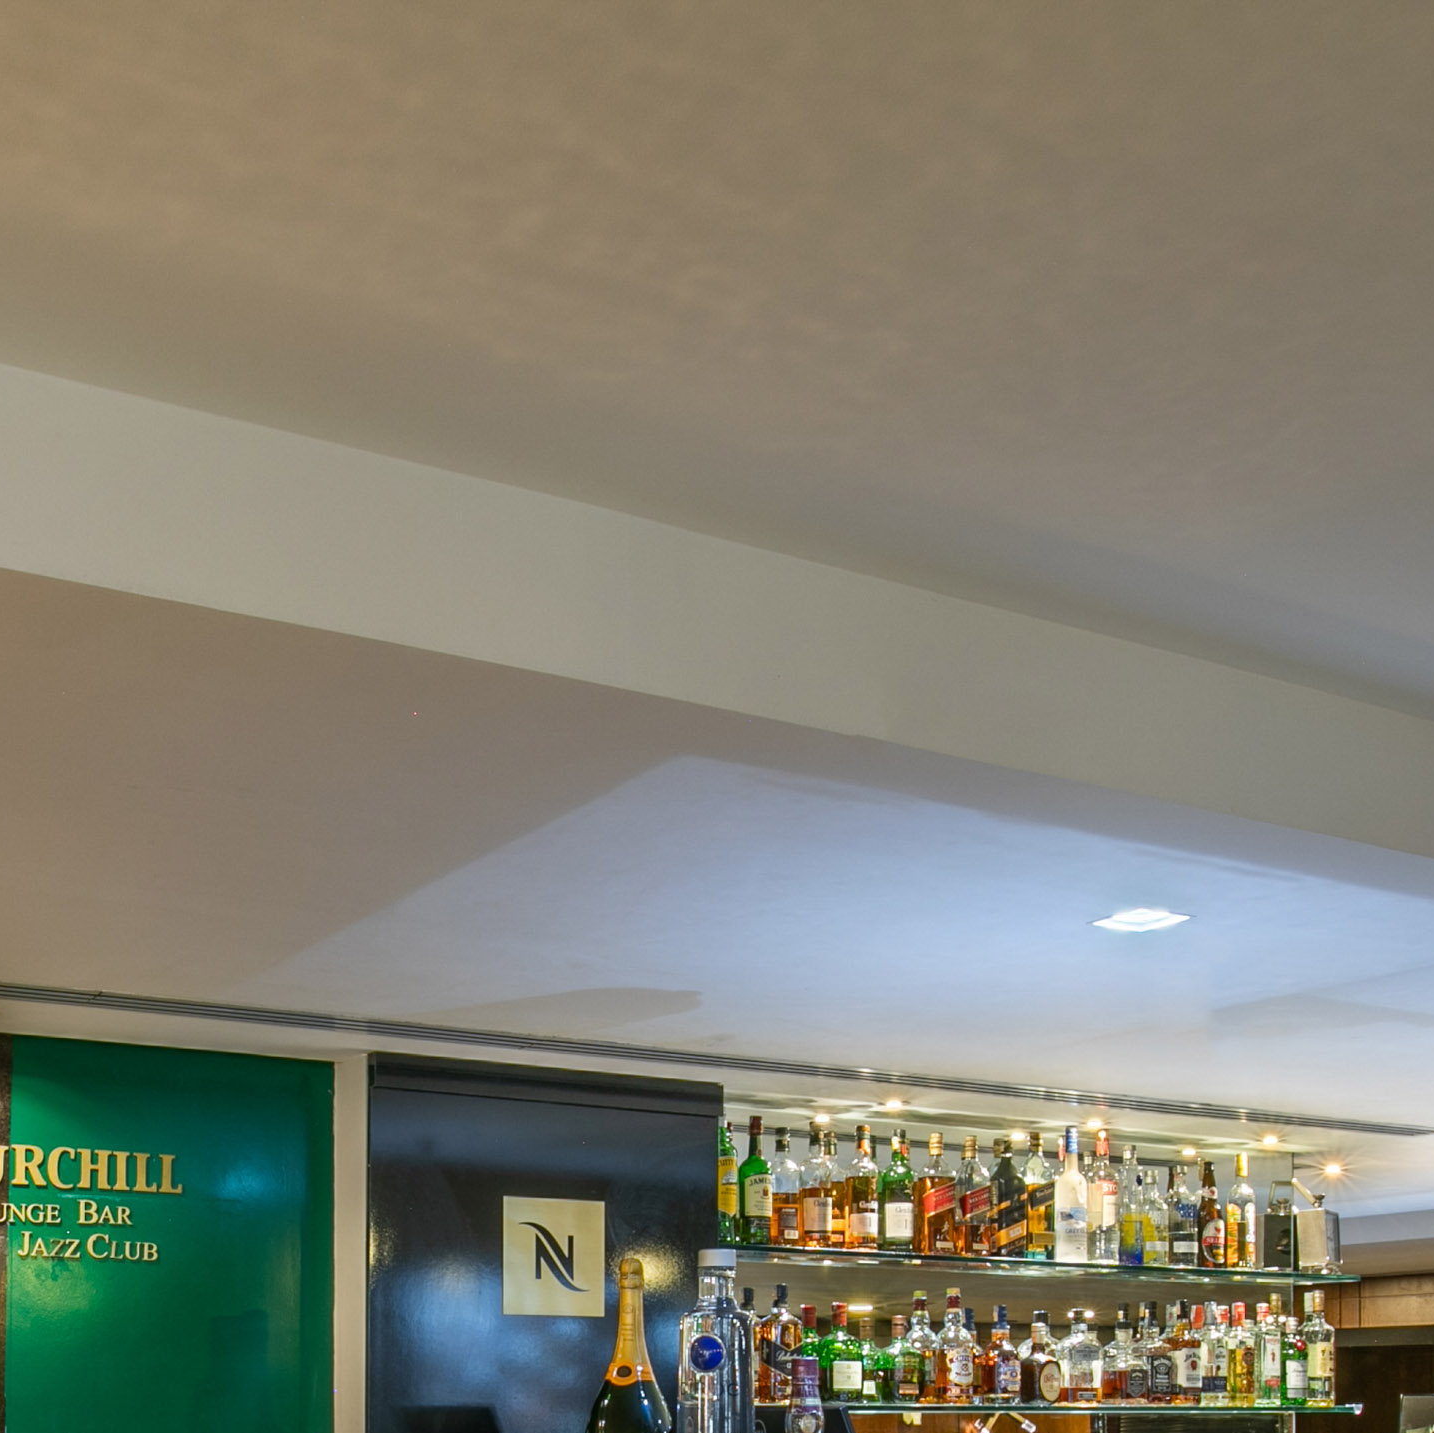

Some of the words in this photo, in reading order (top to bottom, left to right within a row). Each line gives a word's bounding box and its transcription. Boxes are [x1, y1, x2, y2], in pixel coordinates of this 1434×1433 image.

[77, 1200, 133, 1225] BAR
[17, 1231, 81, 1259] JAZZ
[86, 1233, 159, 1261] CLUB
